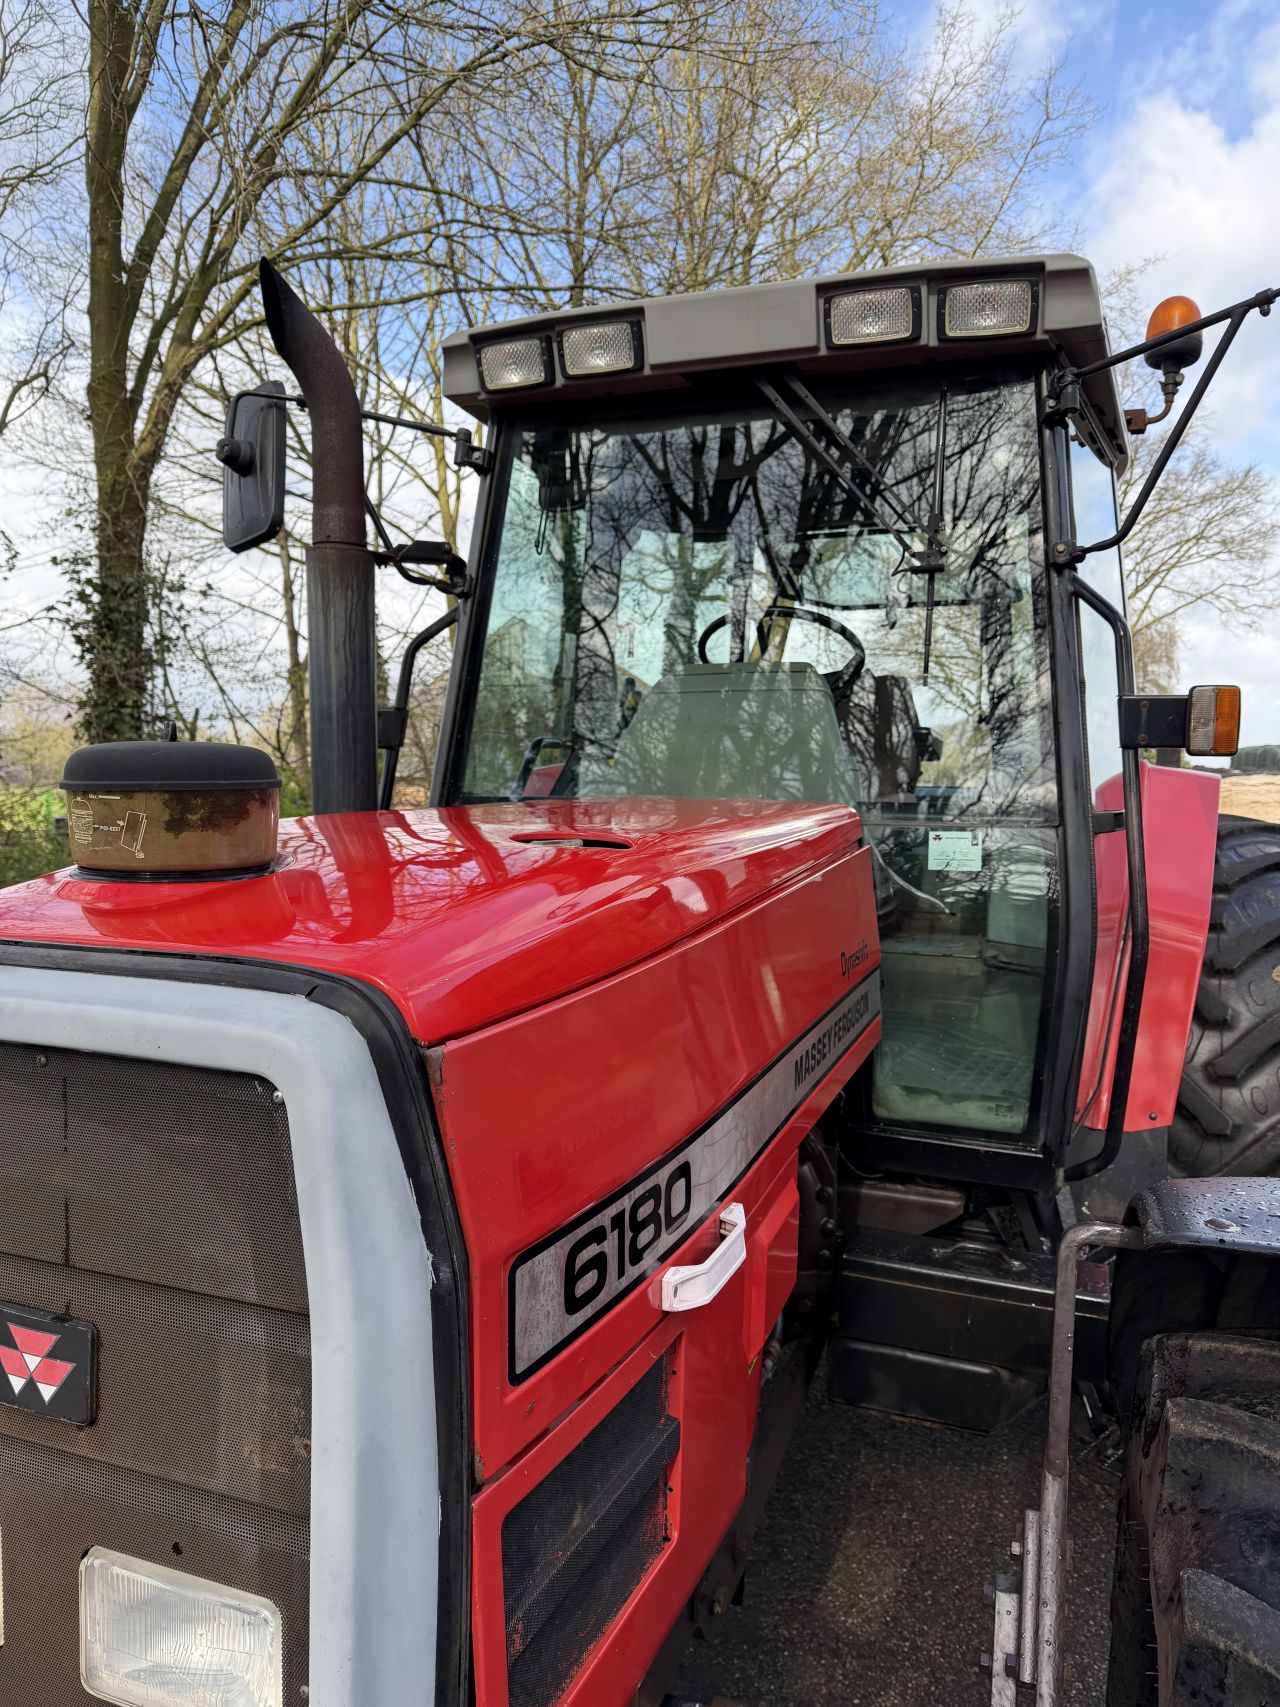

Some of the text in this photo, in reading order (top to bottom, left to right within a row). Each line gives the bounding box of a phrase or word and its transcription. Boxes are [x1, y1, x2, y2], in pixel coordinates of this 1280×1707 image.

[840, 938, 869, 980] Dynashift
[794, 989, 869, 1092] MASSEY FERGUSON
[563, 1160, 692, 1316] 6180
